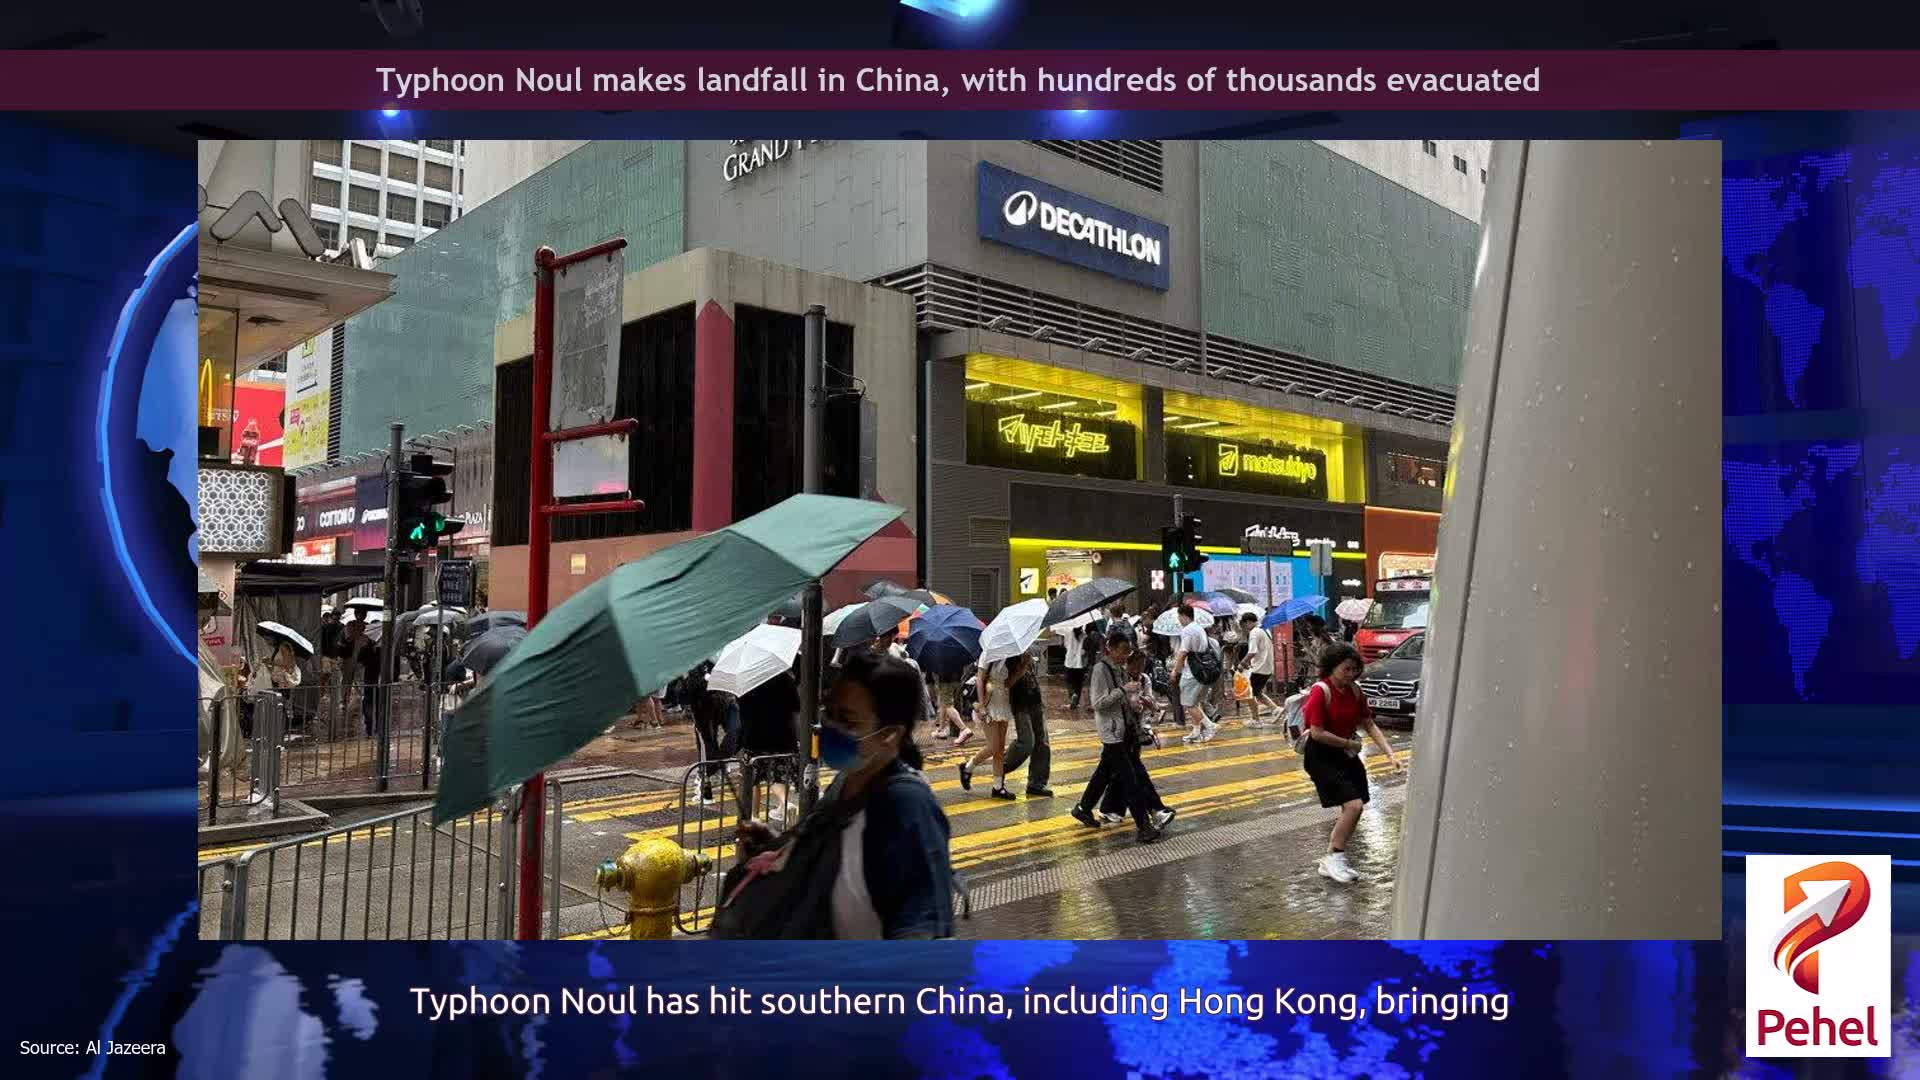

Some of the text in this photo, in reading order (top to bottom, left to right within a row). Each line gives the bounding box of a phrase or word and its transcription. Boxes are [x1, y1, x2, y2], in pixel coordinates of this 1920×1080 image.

[723, 140, 788, 181] GRAND
[1040, 205, 1160, 266] DECATHLON
[1242, 453, 1317, 484] matsukiyo
